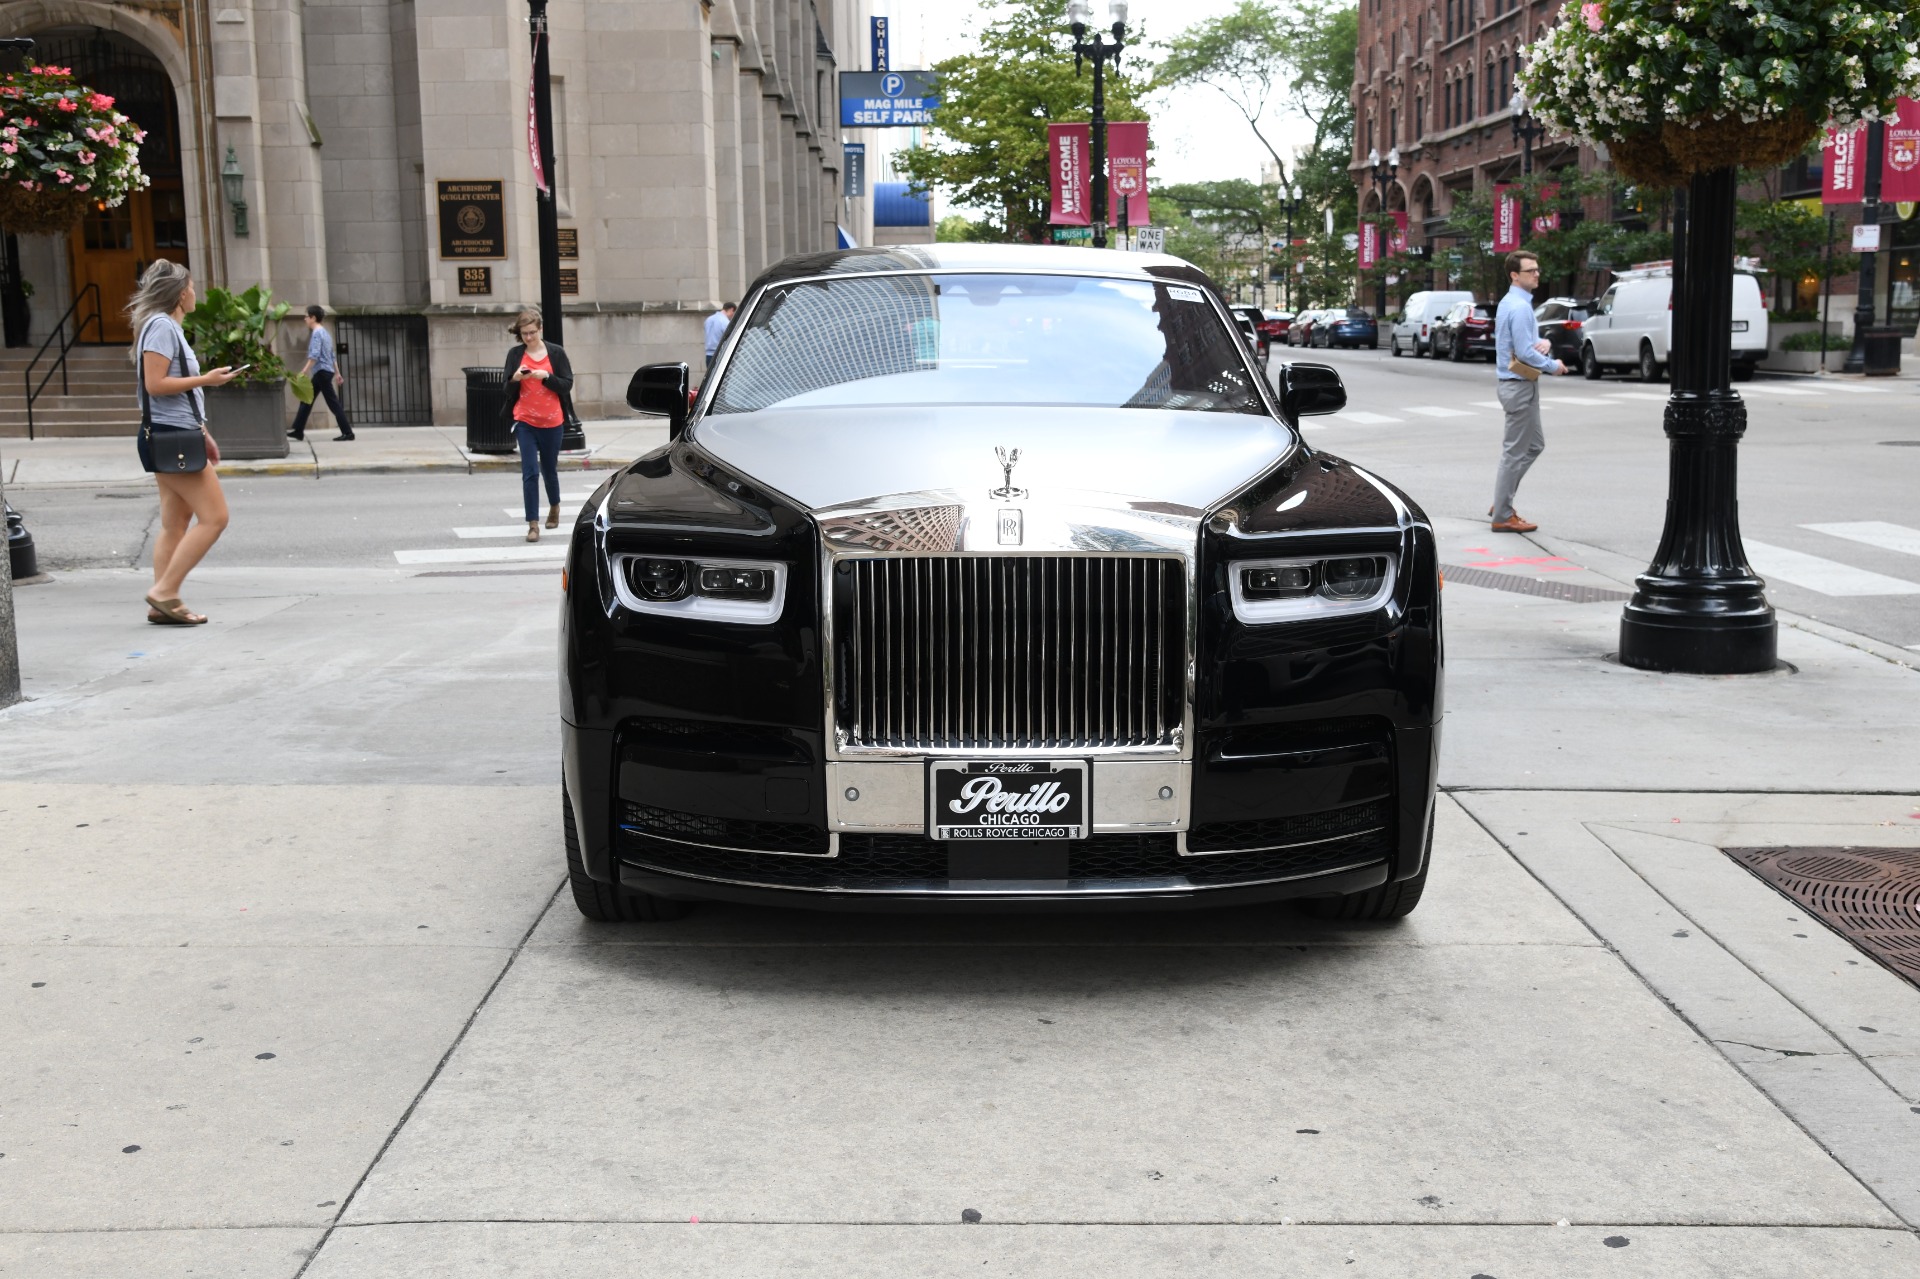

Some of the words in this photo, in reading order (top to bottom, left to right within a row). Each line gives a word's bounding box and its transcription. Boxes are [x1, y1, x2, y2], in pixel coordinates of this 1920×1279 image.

[887, 77, 900, 93] P
[864, 99, 891, 109] MAG
[894, 99, 923, 109] MILE
[853, 111, 890, 123] SELF
[893, 110, 934, 123] PARK
[1889, 129, 1920, 138] LOYOLA
[1847, 139, 1855, 165] TOWER
[1113, 157, 1142, 165] LOYOLA
[1833, 132, 1848, 190] WELCO
[1059, 135, 1074, 214] WELCOME
[1072, 166, 1080, 190] TOWER
[1846, 165, 1855, 190] WATER
[440, 193, 471, 202] QUIGLEY
[1073, 191, 1081, 214] WATER
[1061, 231, 1082, 239] RUSH
[1140, 231, 1160, 240] ONE
[1140, 241, 1160, 250] WAY
[1363, 223, 1371, 263] WELCOME
[464, 268, 485, 280] 835
[985, 763, 1034, 773] Perillo
[949, 776, 1070, 813] Perillo
[979, 814, 1040, 825] CHICAGO
[953, 828, 983, 838] ROLLS
[986, 828, 1018, 838] ROYCE
[1021, 828, 1065, 837] CHICAGO
